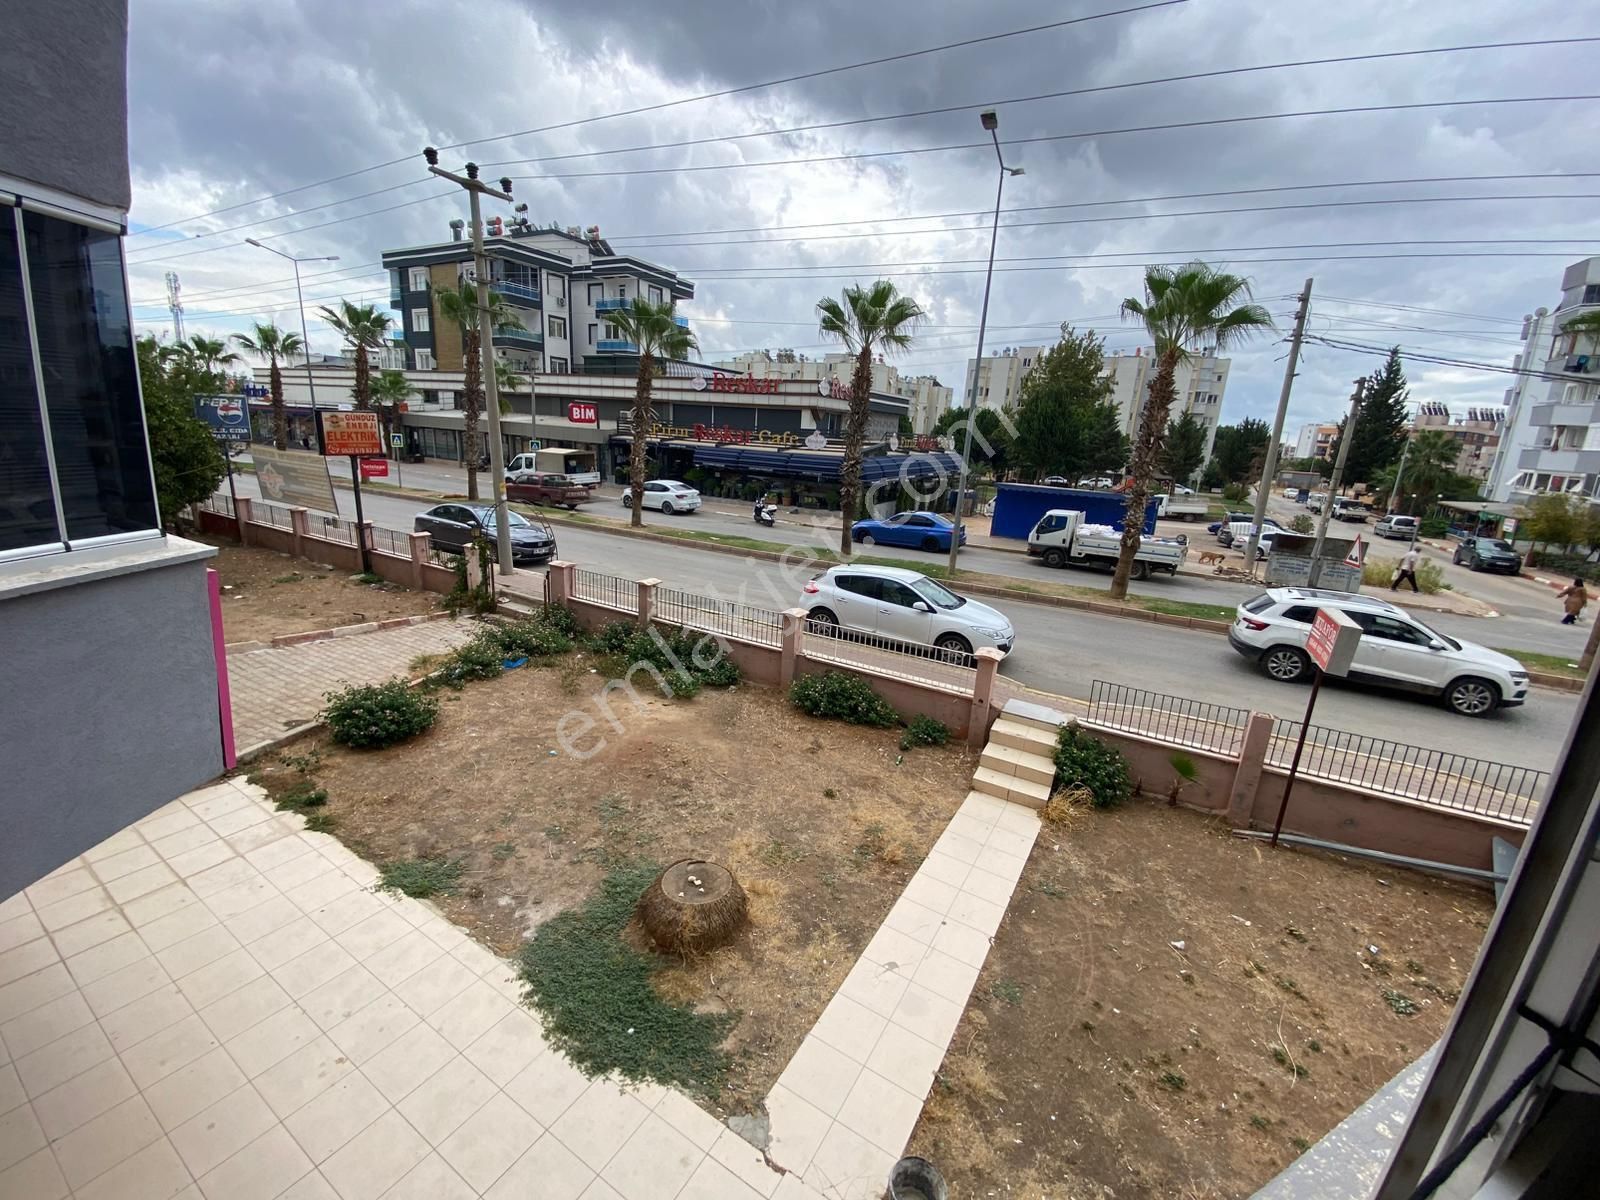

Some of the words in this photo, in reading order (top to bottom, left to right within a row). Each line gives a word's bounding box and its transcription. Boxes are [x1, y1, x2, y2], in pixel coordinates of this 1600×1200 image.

[712, 371, 784, 394] Reskar
[831, 376, 854, 400] Res
[572, 404, 596, 420] BİM
[758, 429, 799, 445] Cafe
